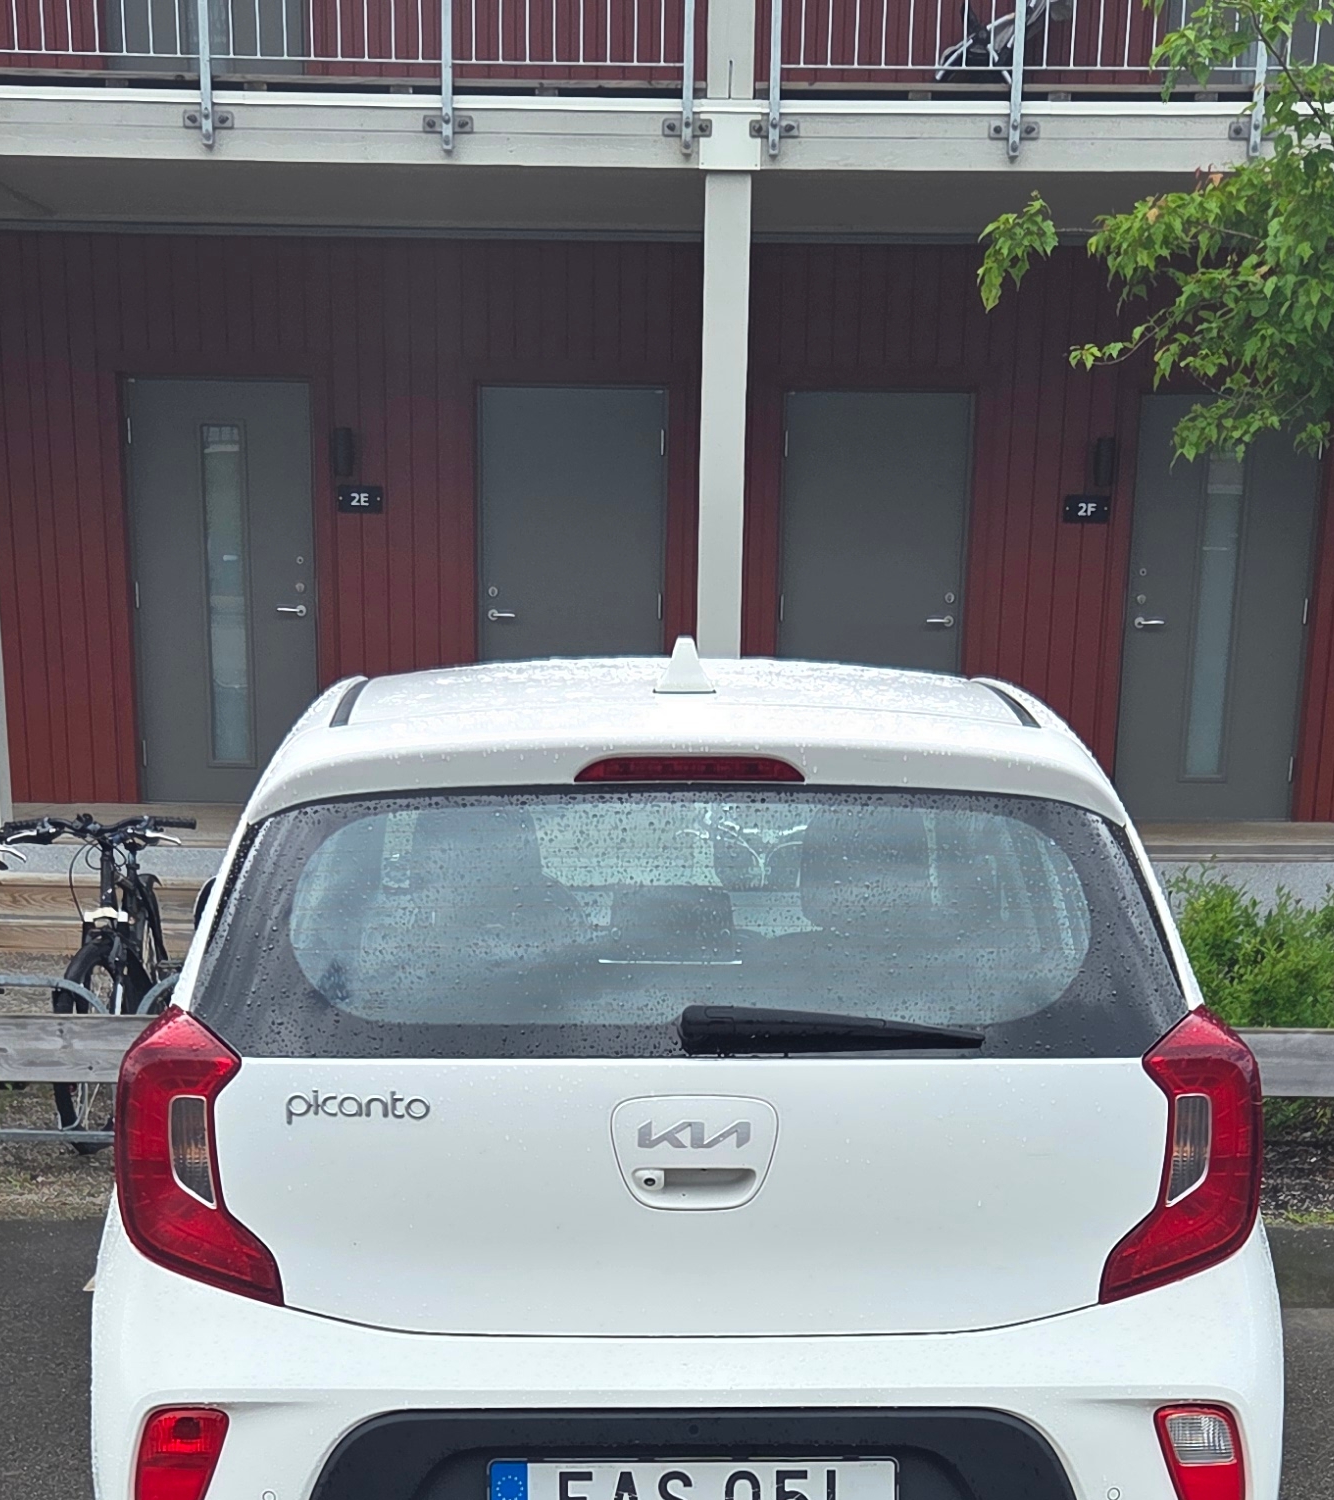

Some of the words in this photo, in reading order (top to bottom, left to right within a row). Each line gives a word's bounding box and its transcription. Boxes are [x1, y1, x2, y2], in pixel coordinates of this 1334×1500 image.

[350, 492, 369, 506] 2E
[1077, 502, 1097, 516] 2F
[285, 1088, 431, 1125] picanto
[637, 1119, 751, 1149] KIA
